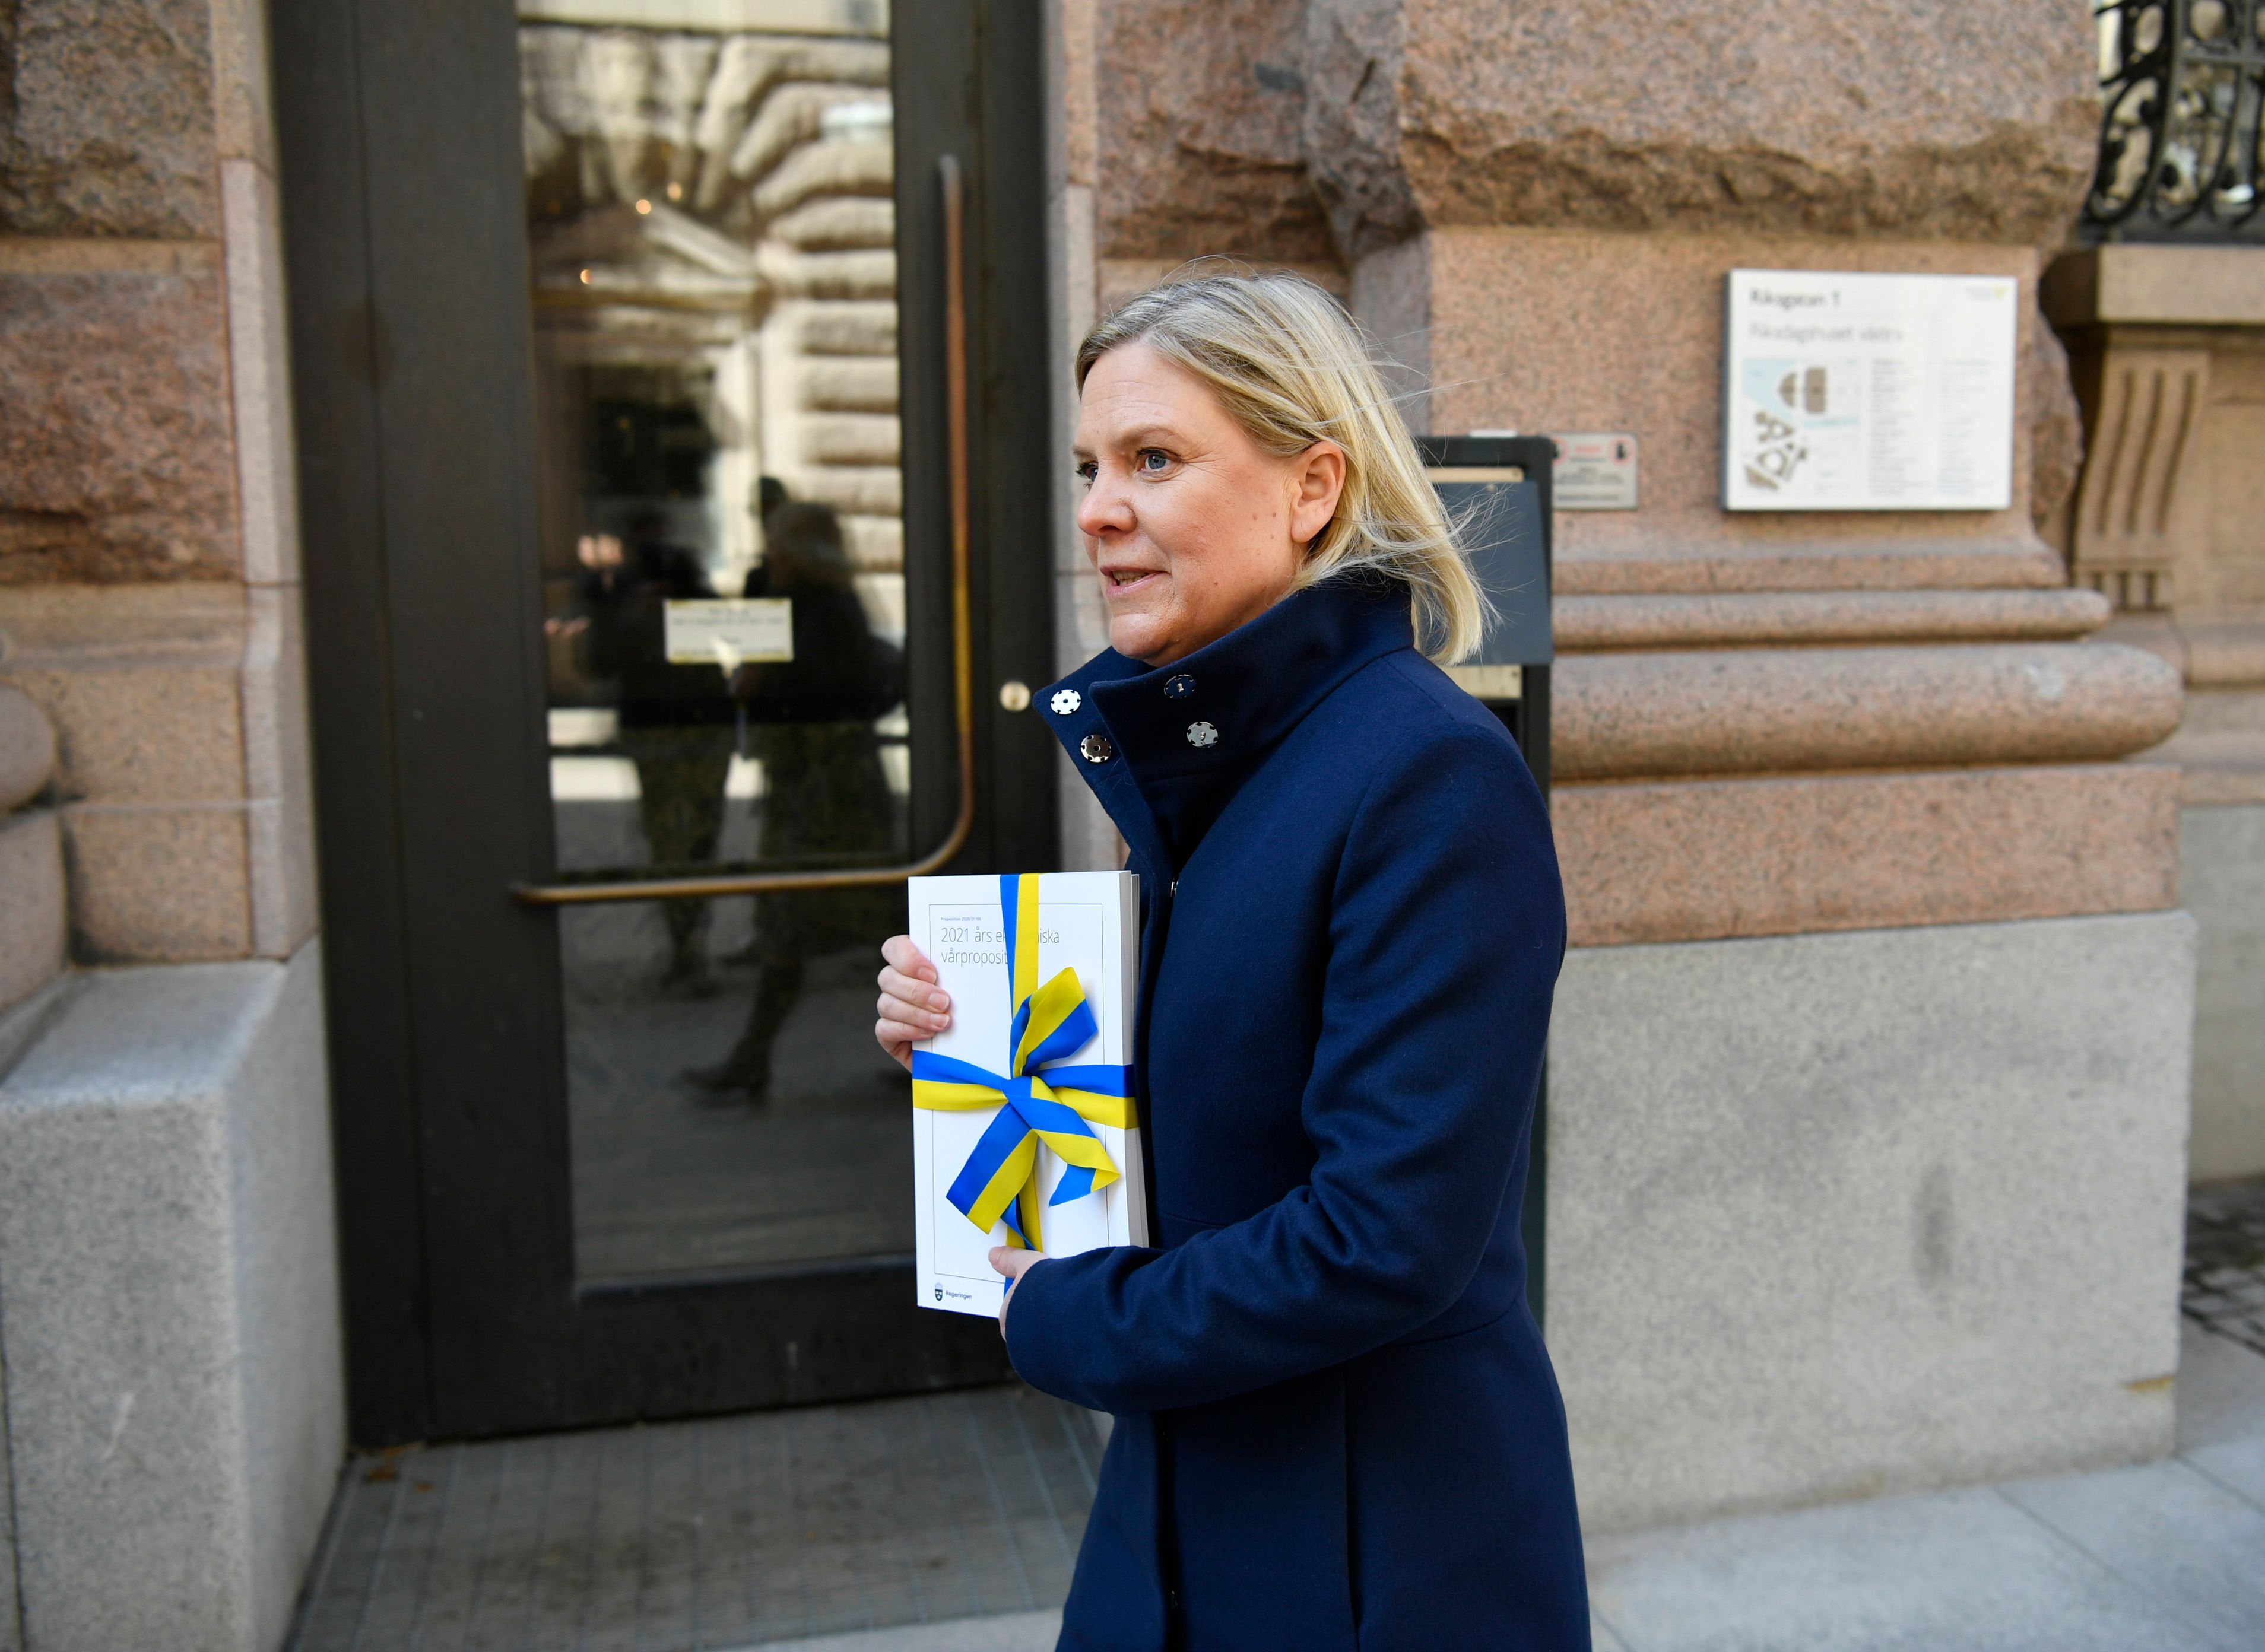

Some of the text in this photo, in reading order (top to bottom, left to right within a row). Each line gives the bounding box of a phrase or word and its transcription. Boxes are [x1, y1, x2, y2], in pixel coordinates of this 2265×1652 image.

[941, 927, 968, 942] 2021
[975, 926, 992, 942] års
[941, 947, 1008, 968] vårproposit
[946, 1290, 972, 1300] Regeringen
